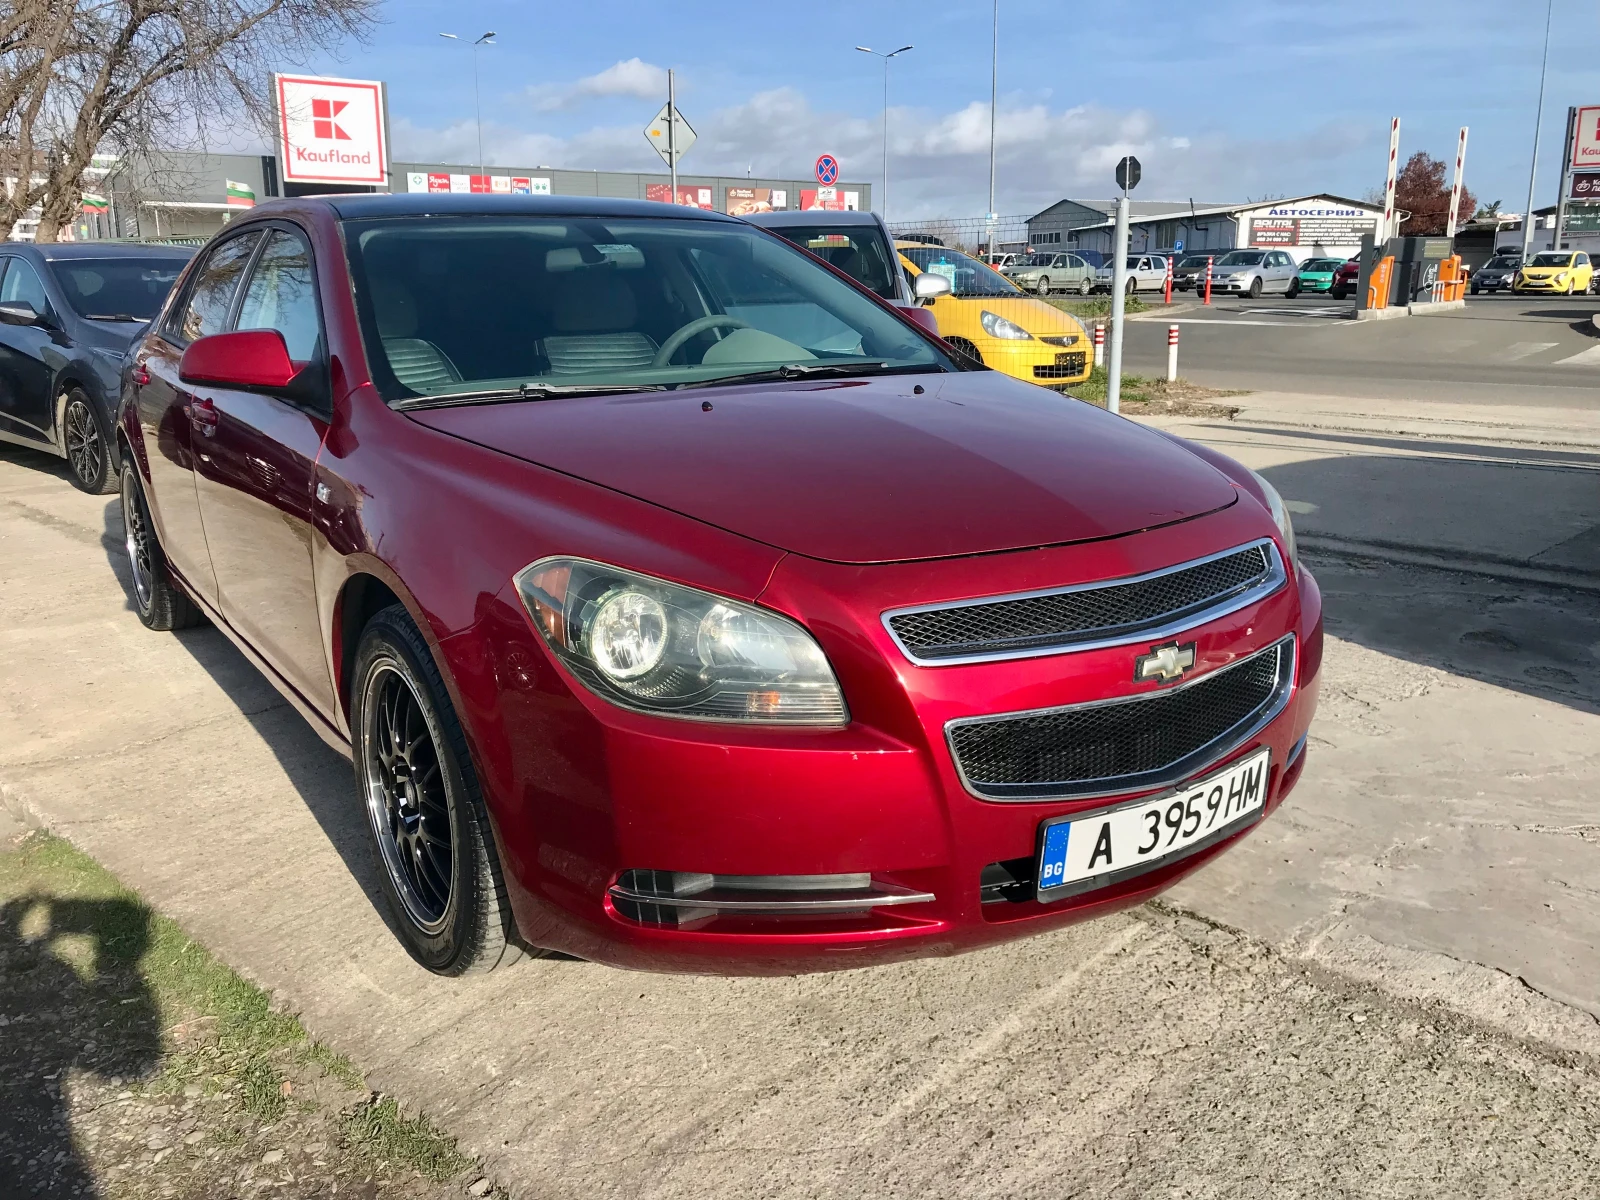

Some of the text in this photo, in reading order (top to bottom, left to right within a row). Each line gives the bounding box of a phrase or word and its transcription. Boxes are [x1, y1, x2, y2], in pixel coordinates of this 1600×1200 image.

[296, 147, 371, 164] Kaufland
[1268, 209, 1364, 217] АВТОСЕРВИЗ
[1087, 821, 1113, 870] A
[1043, 861, 1063, 879] BG
